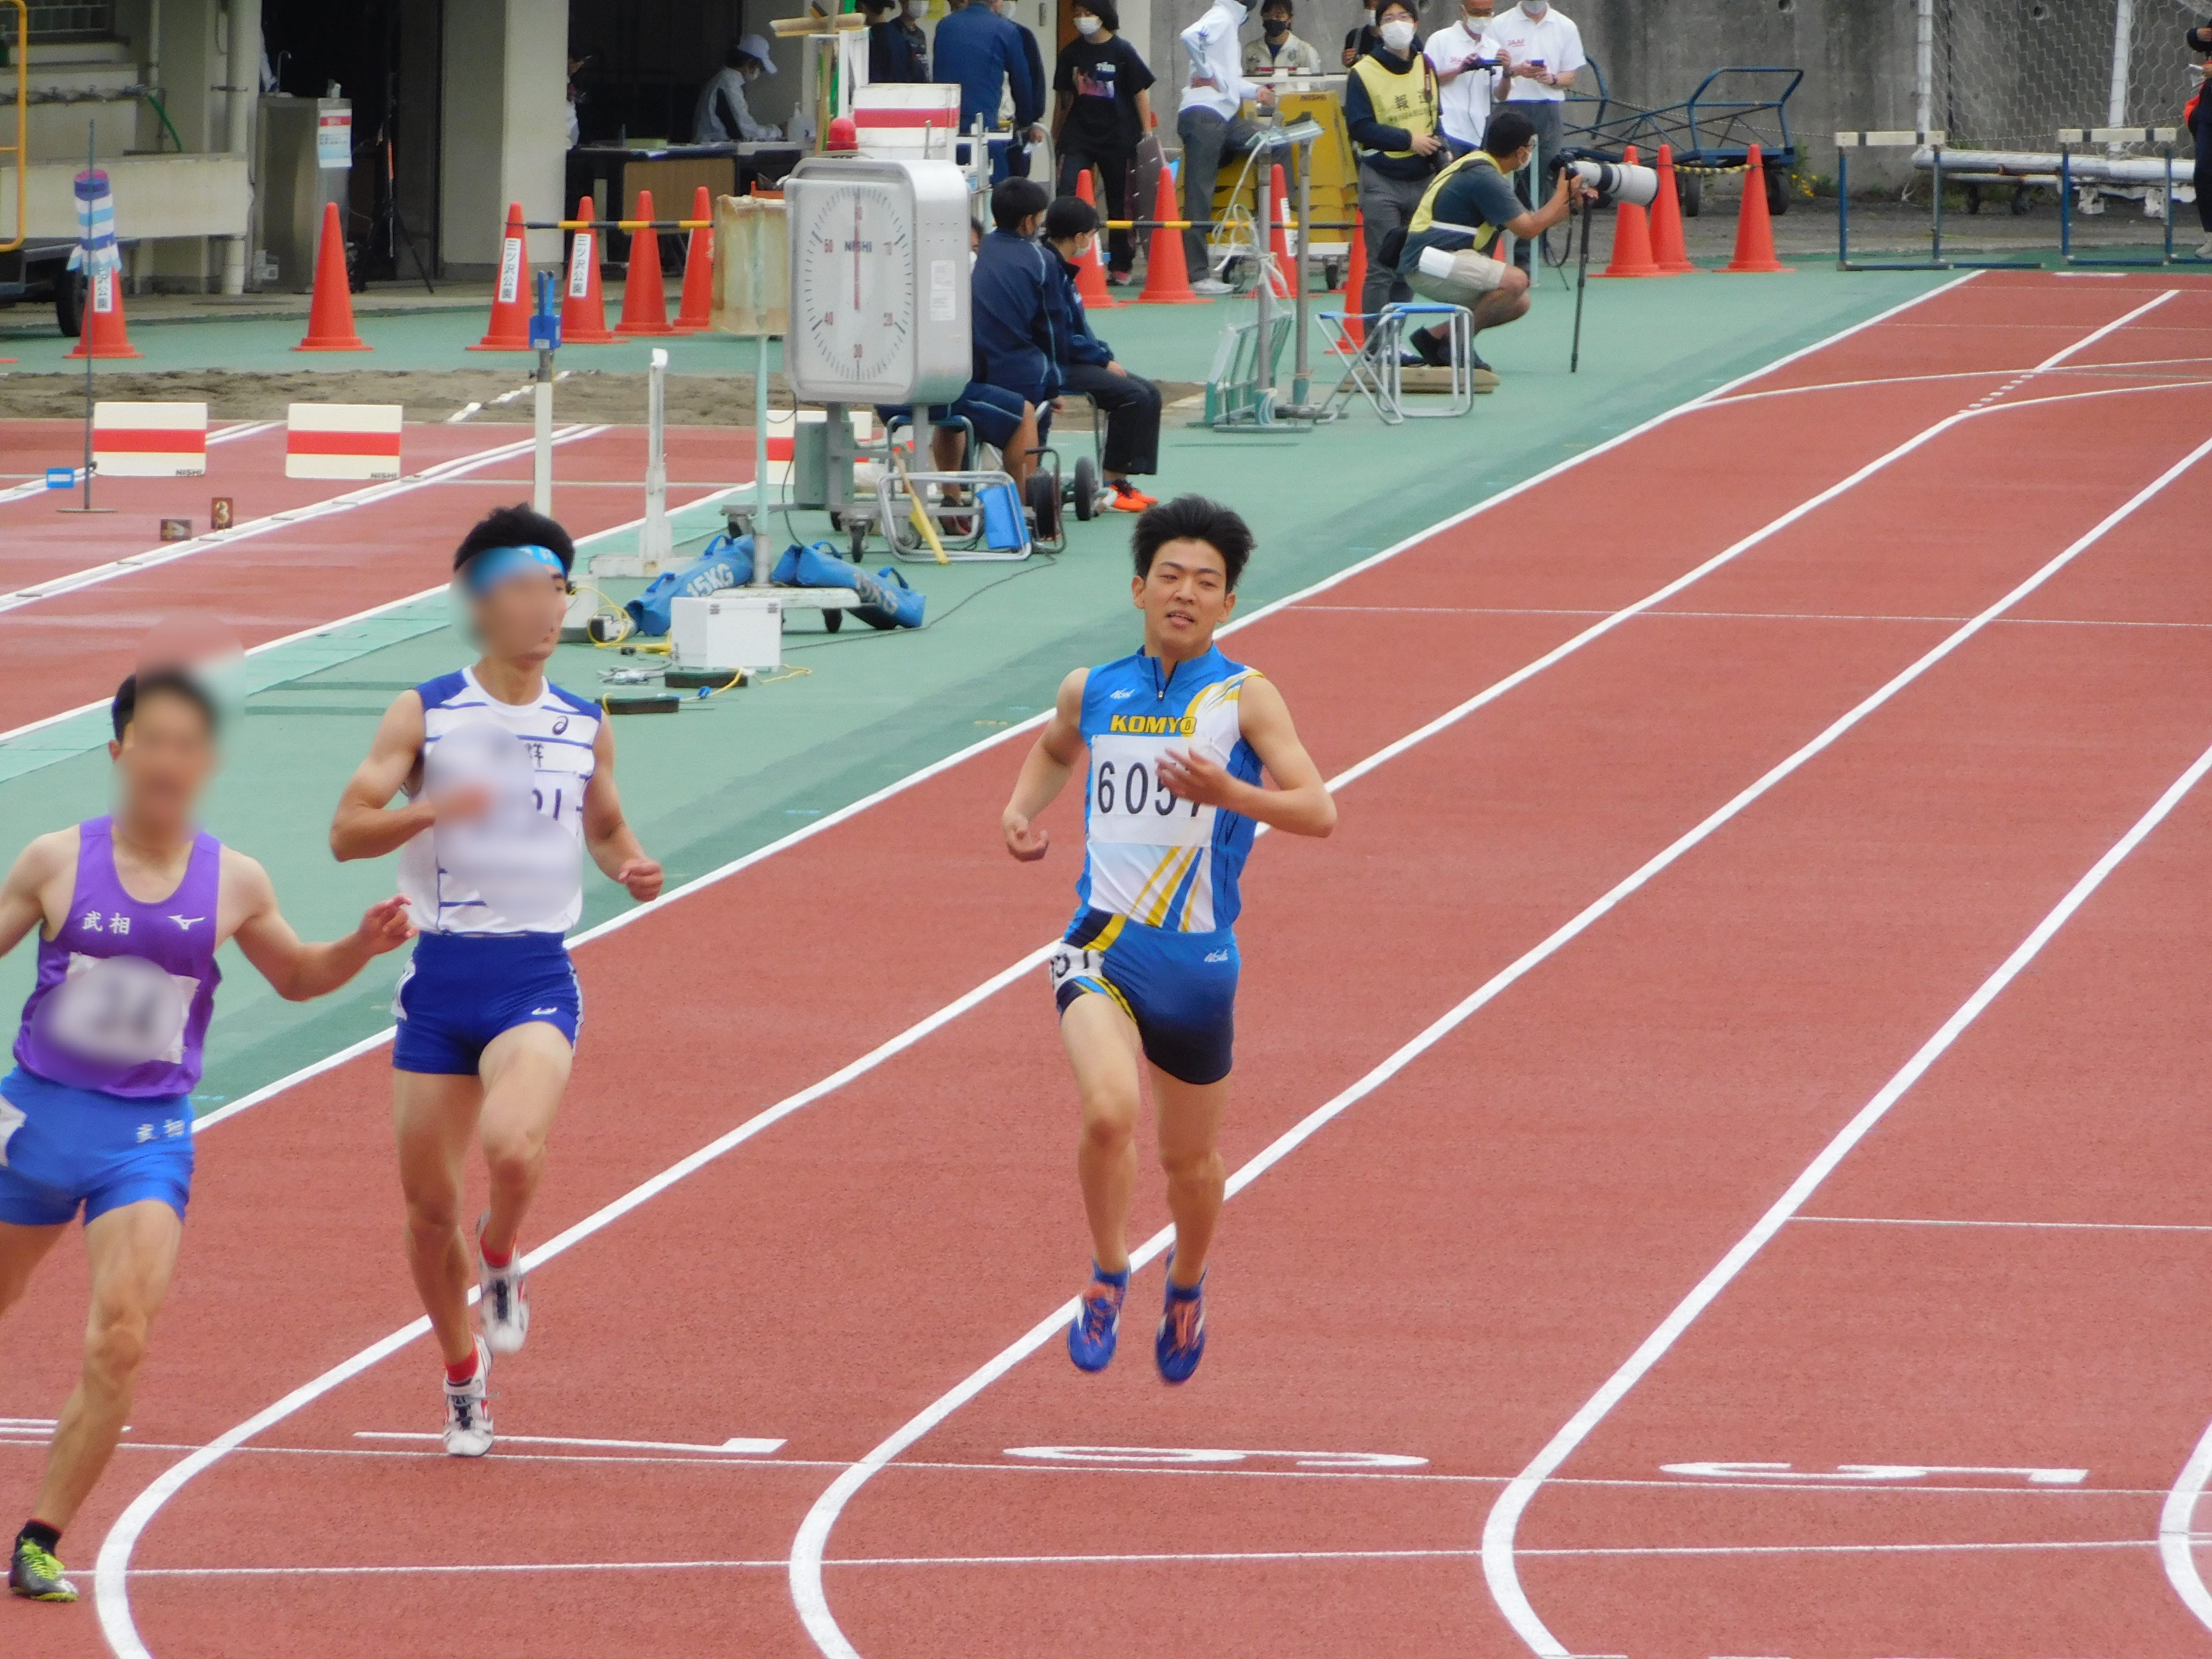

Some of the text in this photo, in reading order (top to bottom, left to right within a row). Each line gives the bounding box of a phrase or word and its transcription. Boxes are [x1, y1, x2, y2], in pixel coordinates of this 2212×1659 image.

[502, 240, 517, 299] 三ツ沢公園
[573, 235, 587, 293] 三ツ沢公園
[216, 501, 230, 524] 3
[686, 563, 734, 596] 15KG
[1110, 714, 1197, 734] KOMYO
[83, 910, 131, 935] 武相
[136, 1119, 185, 1143] 武相
